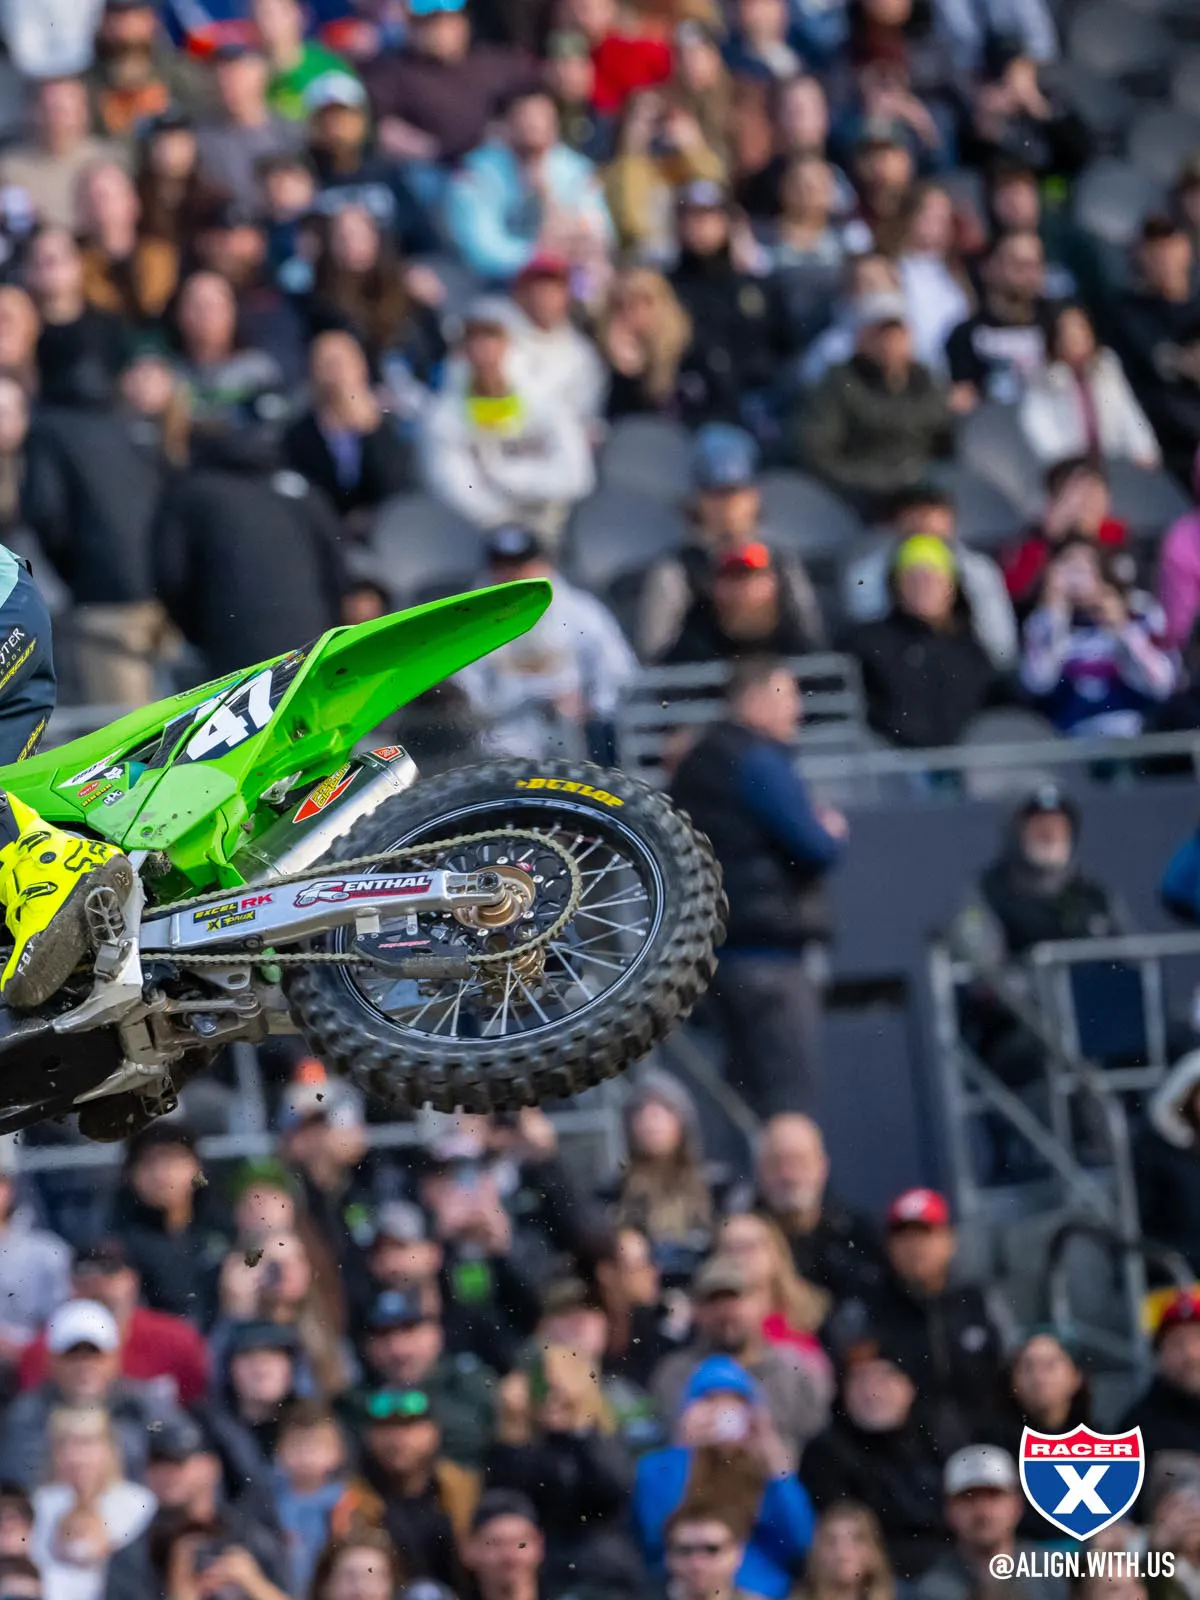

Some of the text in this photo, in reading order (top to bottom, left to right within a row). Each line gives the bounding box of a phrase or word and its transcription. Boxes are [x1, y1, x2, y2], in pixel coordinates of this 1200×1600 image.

[186, 669, 274, 761] 47
[525, 778, 625, 807] DUNLOP
[195, 903, 237, 919] EXCEL
[241, 893, 273, 909] RK
